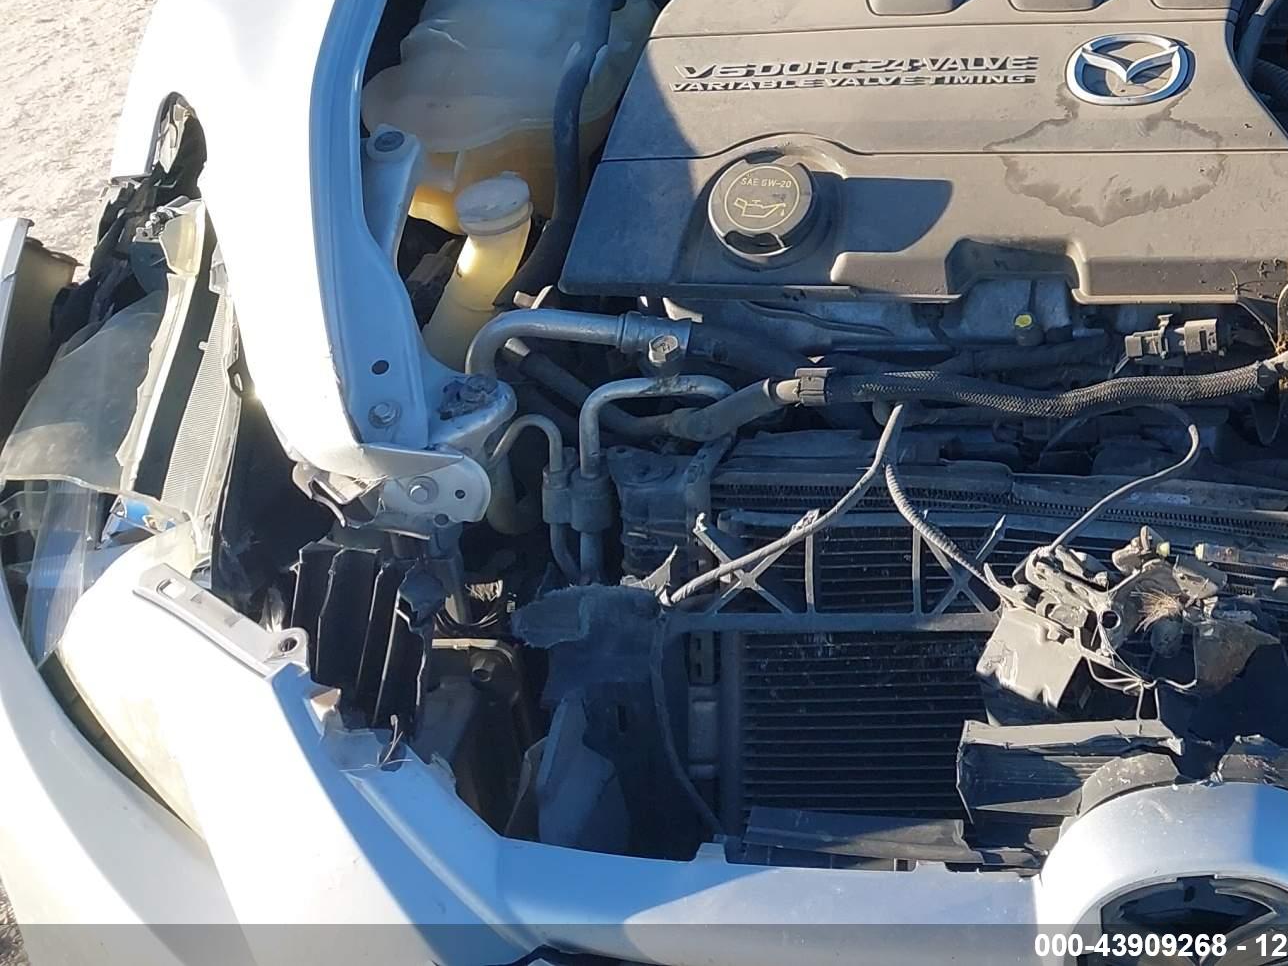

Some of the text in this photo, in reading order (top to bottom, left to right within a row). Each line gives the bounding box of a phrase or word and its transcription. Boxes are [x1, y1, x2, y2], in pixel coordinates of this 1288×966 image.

[669, 73, 1036, 92] VARIABLE VALVE TIMING
[741, 178, 760, 186] SAE
